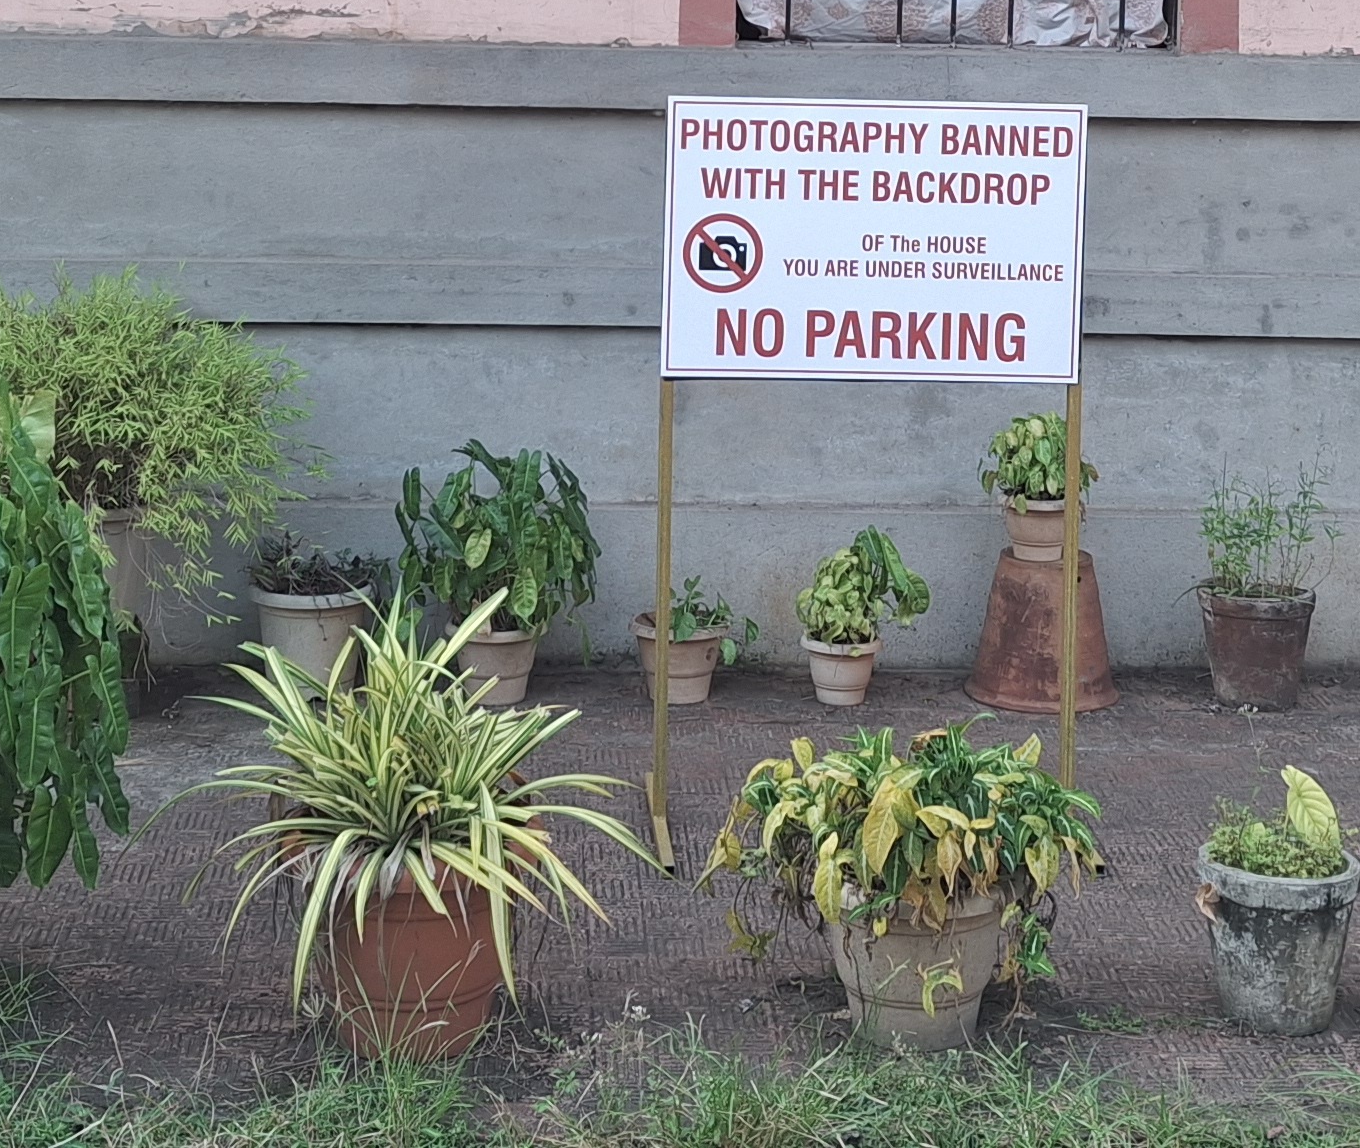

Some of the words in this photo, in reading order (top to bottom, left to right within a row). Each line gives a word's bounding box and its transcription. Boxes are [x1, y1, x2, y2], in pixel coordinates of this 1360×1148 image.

[680, 118, 929, 155] PHOTOGRAPHY
[940, 123, 1074, 158] BANNED
[700, 167, 786, 200] WITH
[797, 168, 860, 202] THE
[872, 171, 1051, 206] BACKDROP
[861, 234, 885, 252] OF
[890, 234, 921, 253] The
[927, 235, 987, 254] HOUSE
[783, 258, 819, 277] YOU
[825, 259, 859, 277] ARE
[865, 260, 926, 279] UNDER
[932, 262, 1064, 282] SURVEILLANCE
[715, 307, 785, 358] NO
[805, 309, 1026, 363] PARKING
